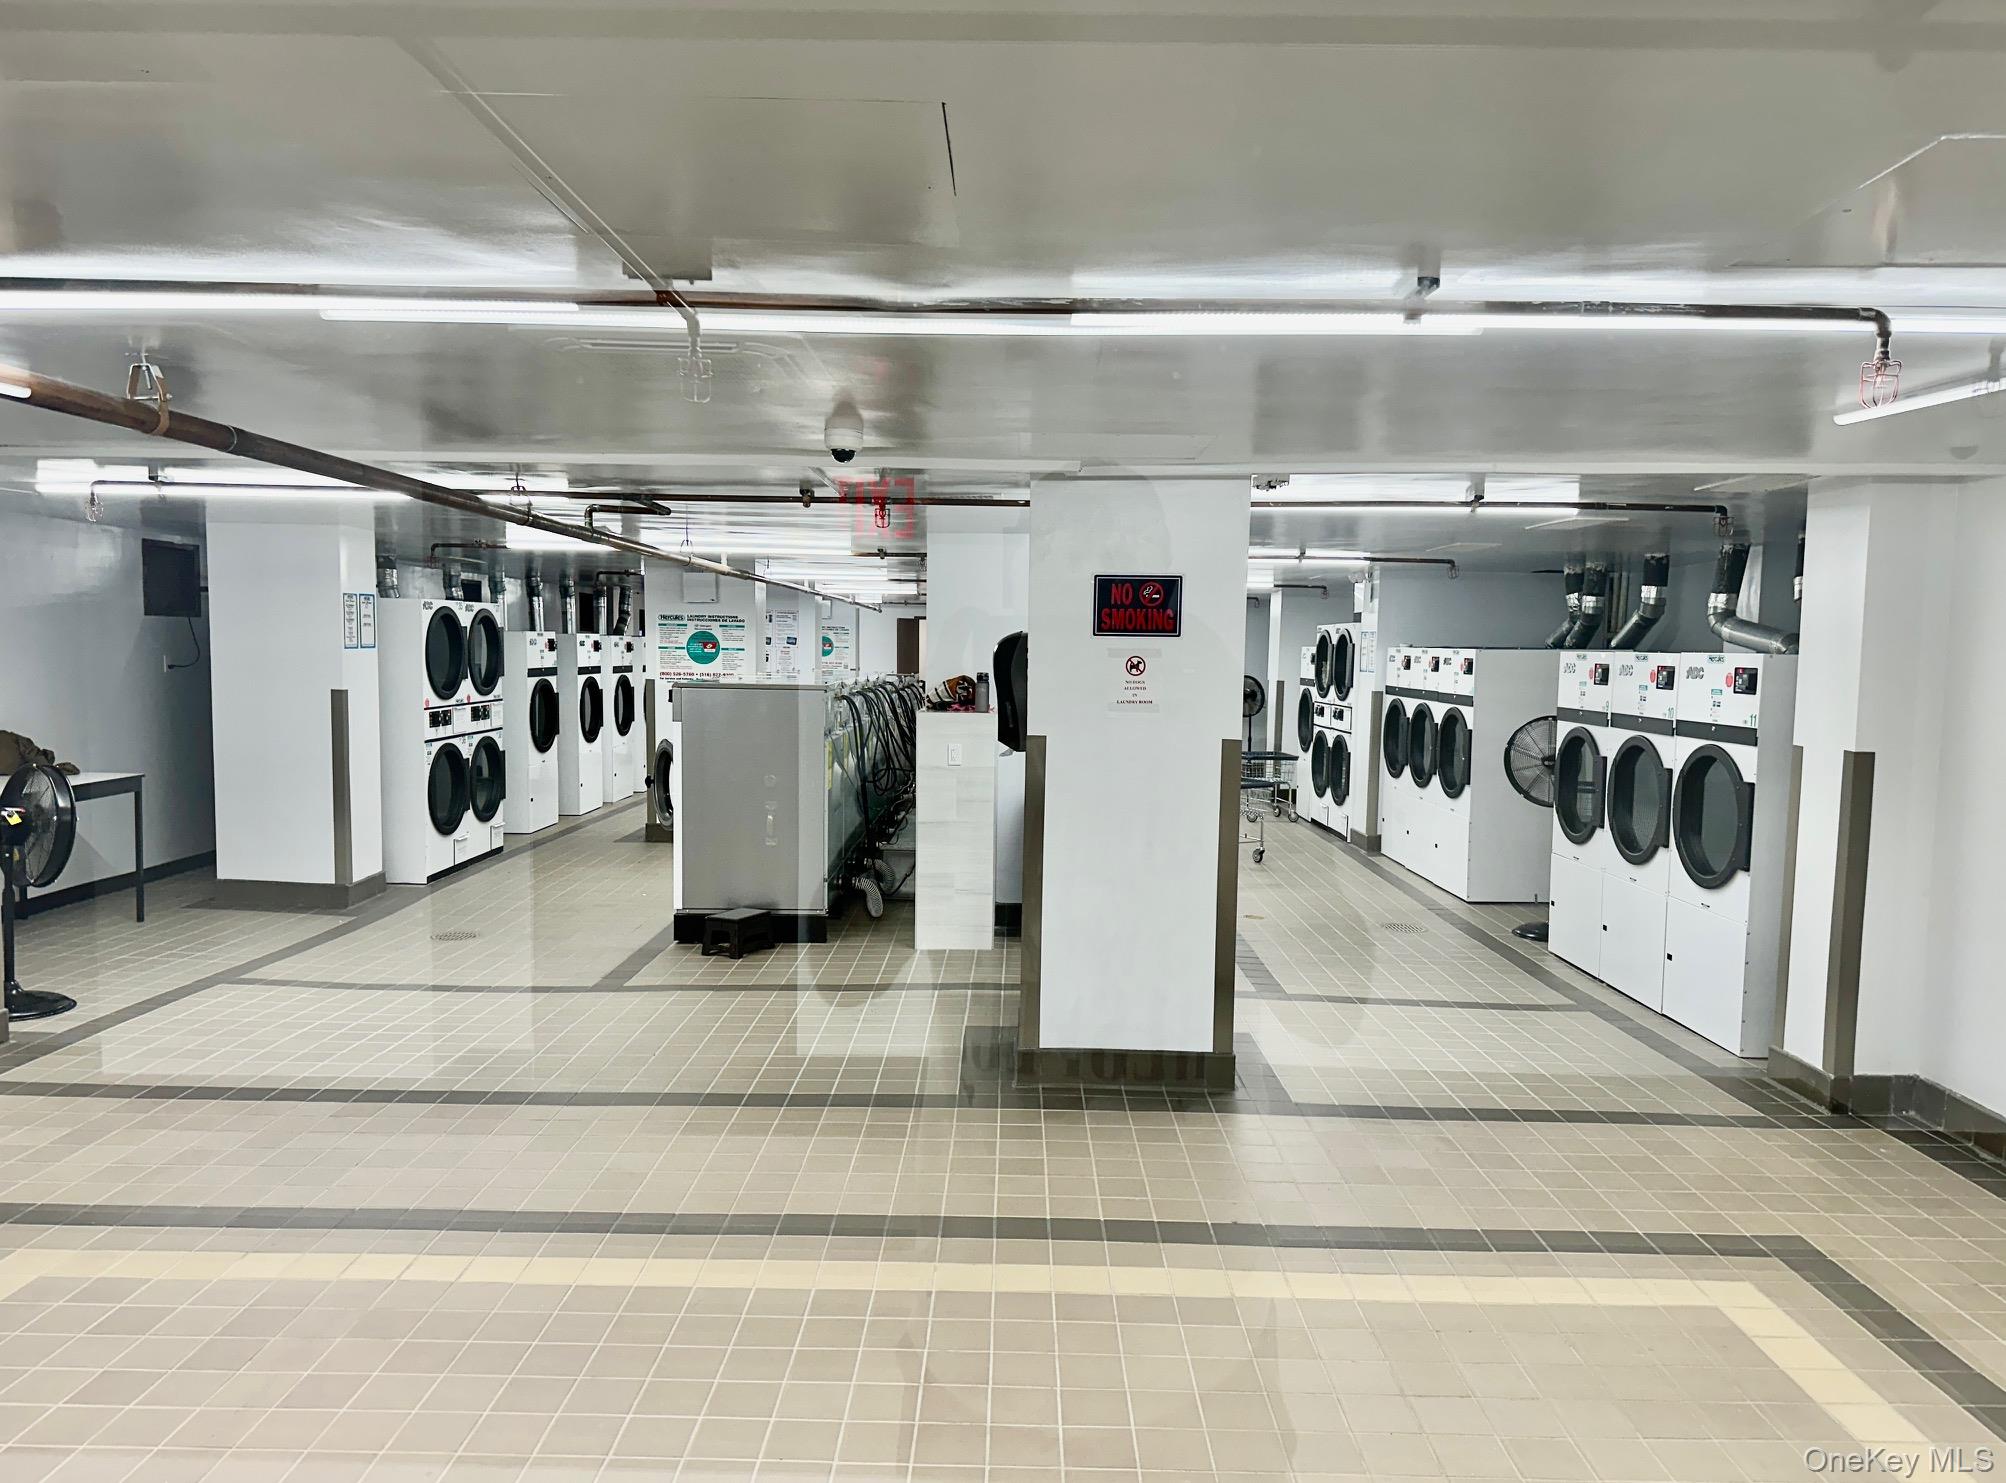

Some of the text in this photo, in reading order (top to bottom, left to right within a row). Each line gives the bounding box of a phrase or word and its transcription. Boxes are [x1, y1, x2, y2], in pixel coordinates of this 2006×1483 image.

[1110, 582, 1133, 605] NO
[1101, 608, 1175, 631] SMOKING
[1750, 714, 1757, 727] 11
